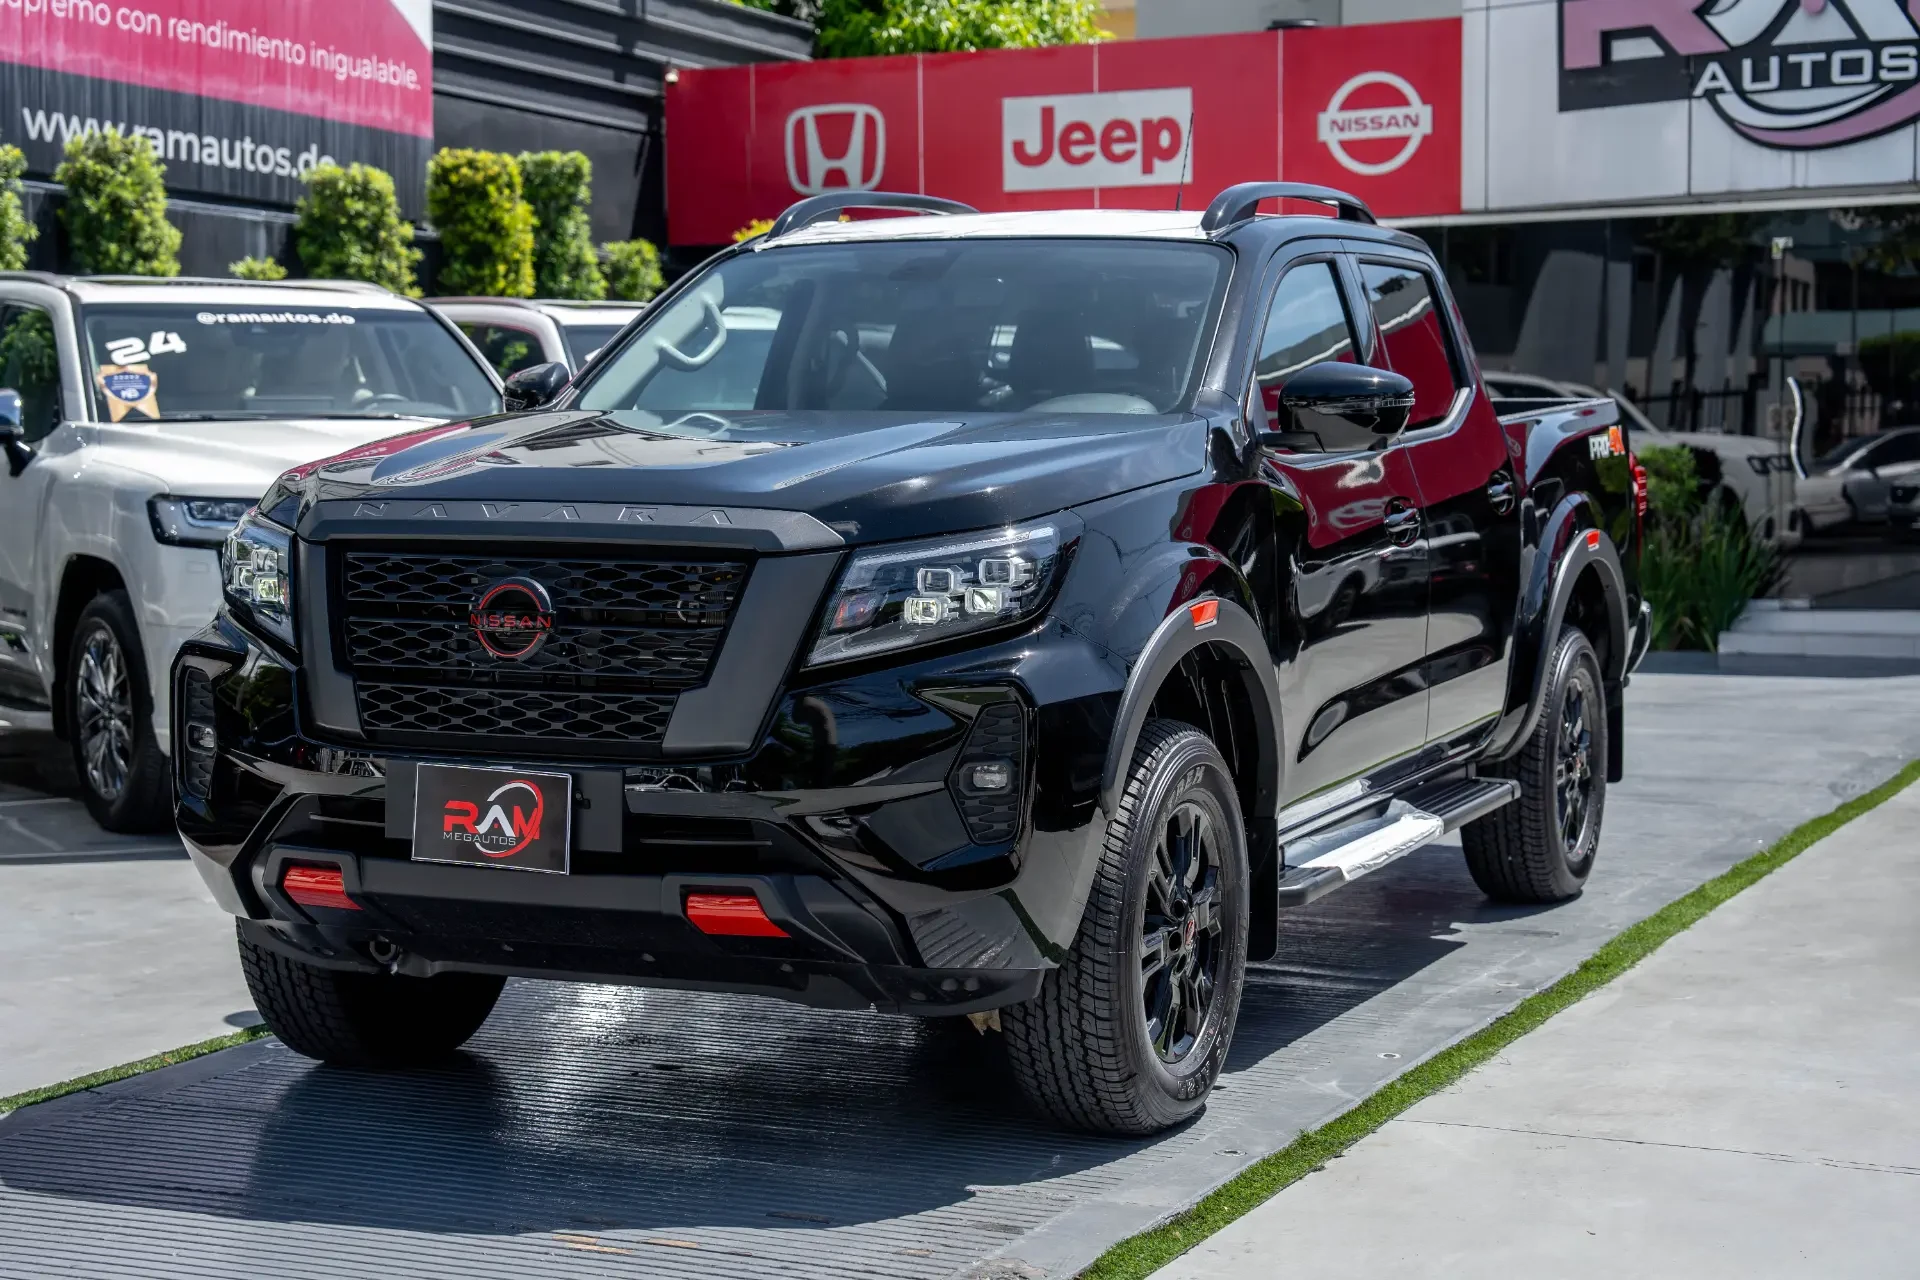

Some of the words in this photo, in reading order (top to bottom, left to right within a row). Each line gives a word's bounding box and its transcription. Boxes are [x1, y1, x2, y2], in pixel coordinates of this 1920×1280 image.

[116, 7, 162, 36] con
[168, 16, 306, 65] rendimiento
[310, 41, 421, 90] inigualable.
[1692, 45, 1919, 97] AUTOS
[1329, 112, 1420, 134] NISSAN
[1012, 106, 1184, 175] Jeep
[196, 311, 356, 325] @ramautos.do
[105, 330, 187, 366] 24
[353, 502, 733, 526] NAVARA
[470, 613, 552, 629] NISSAN
[443, 800, 541, 840] RAM
[443, 831, 518, 846] MEGAUTOS
